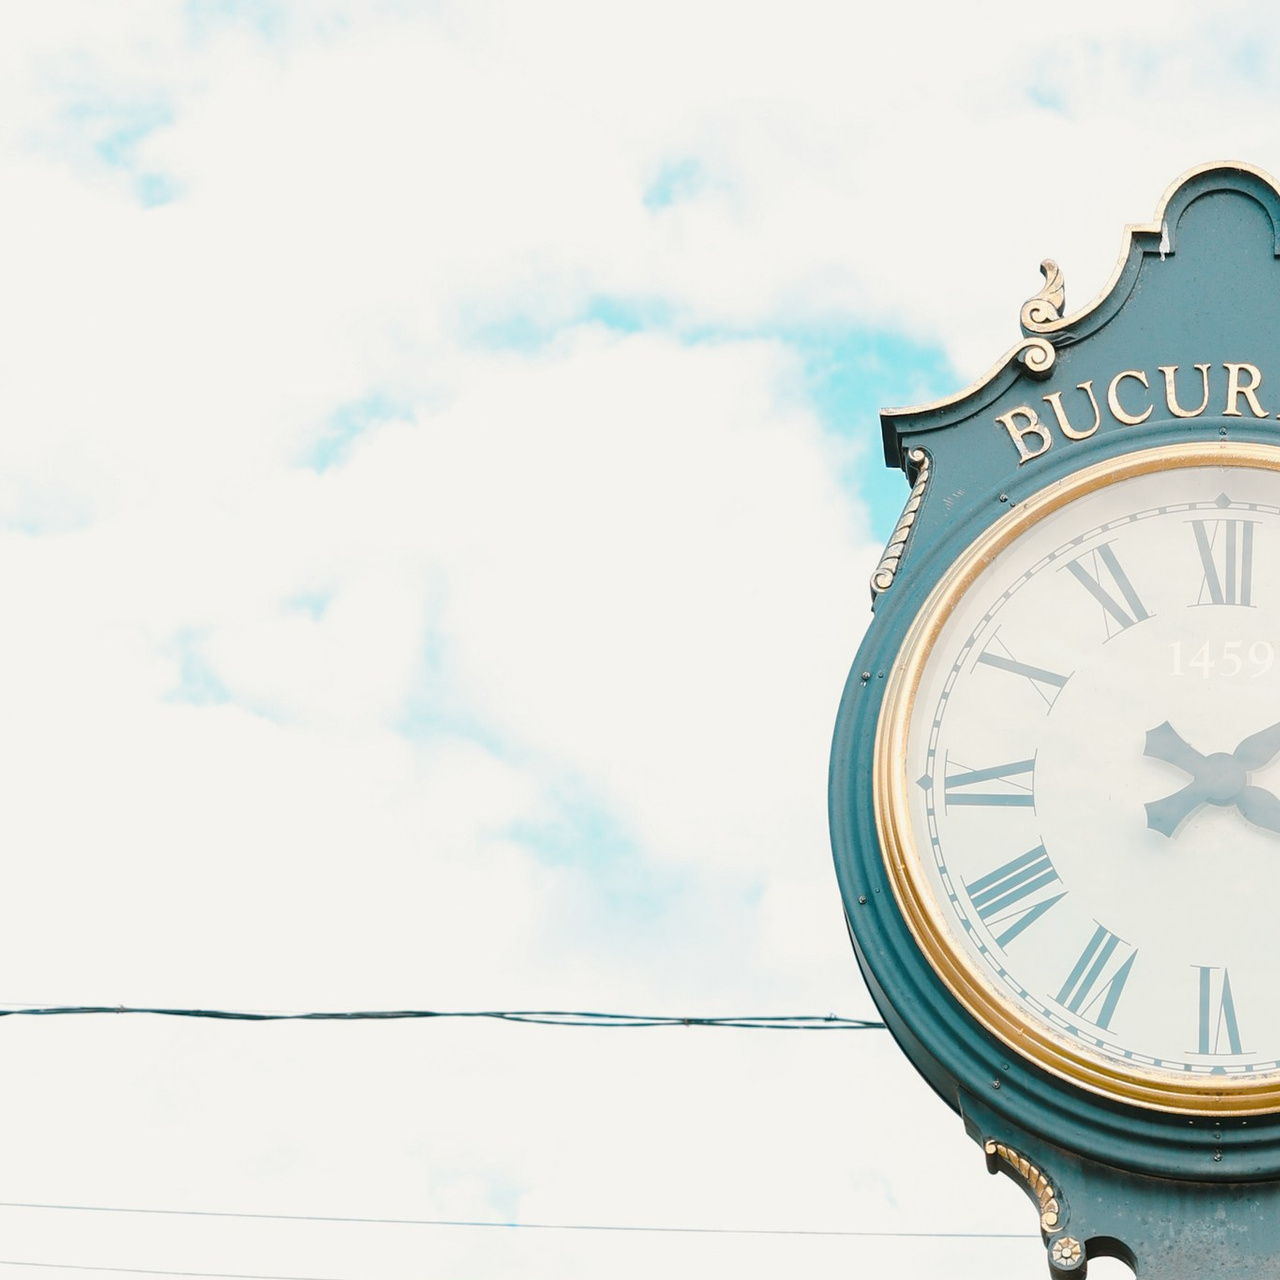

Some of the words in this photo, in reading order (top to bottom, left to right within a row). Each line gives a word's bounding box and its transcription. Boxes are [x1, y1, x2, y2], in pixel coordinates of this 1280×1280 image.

[1056, 538, 1157, 645] XI
[1183, 519, 1263, 608] XII
[970, 624, 1075, 716] X
[1168, 639, 1275, 680] 1459
